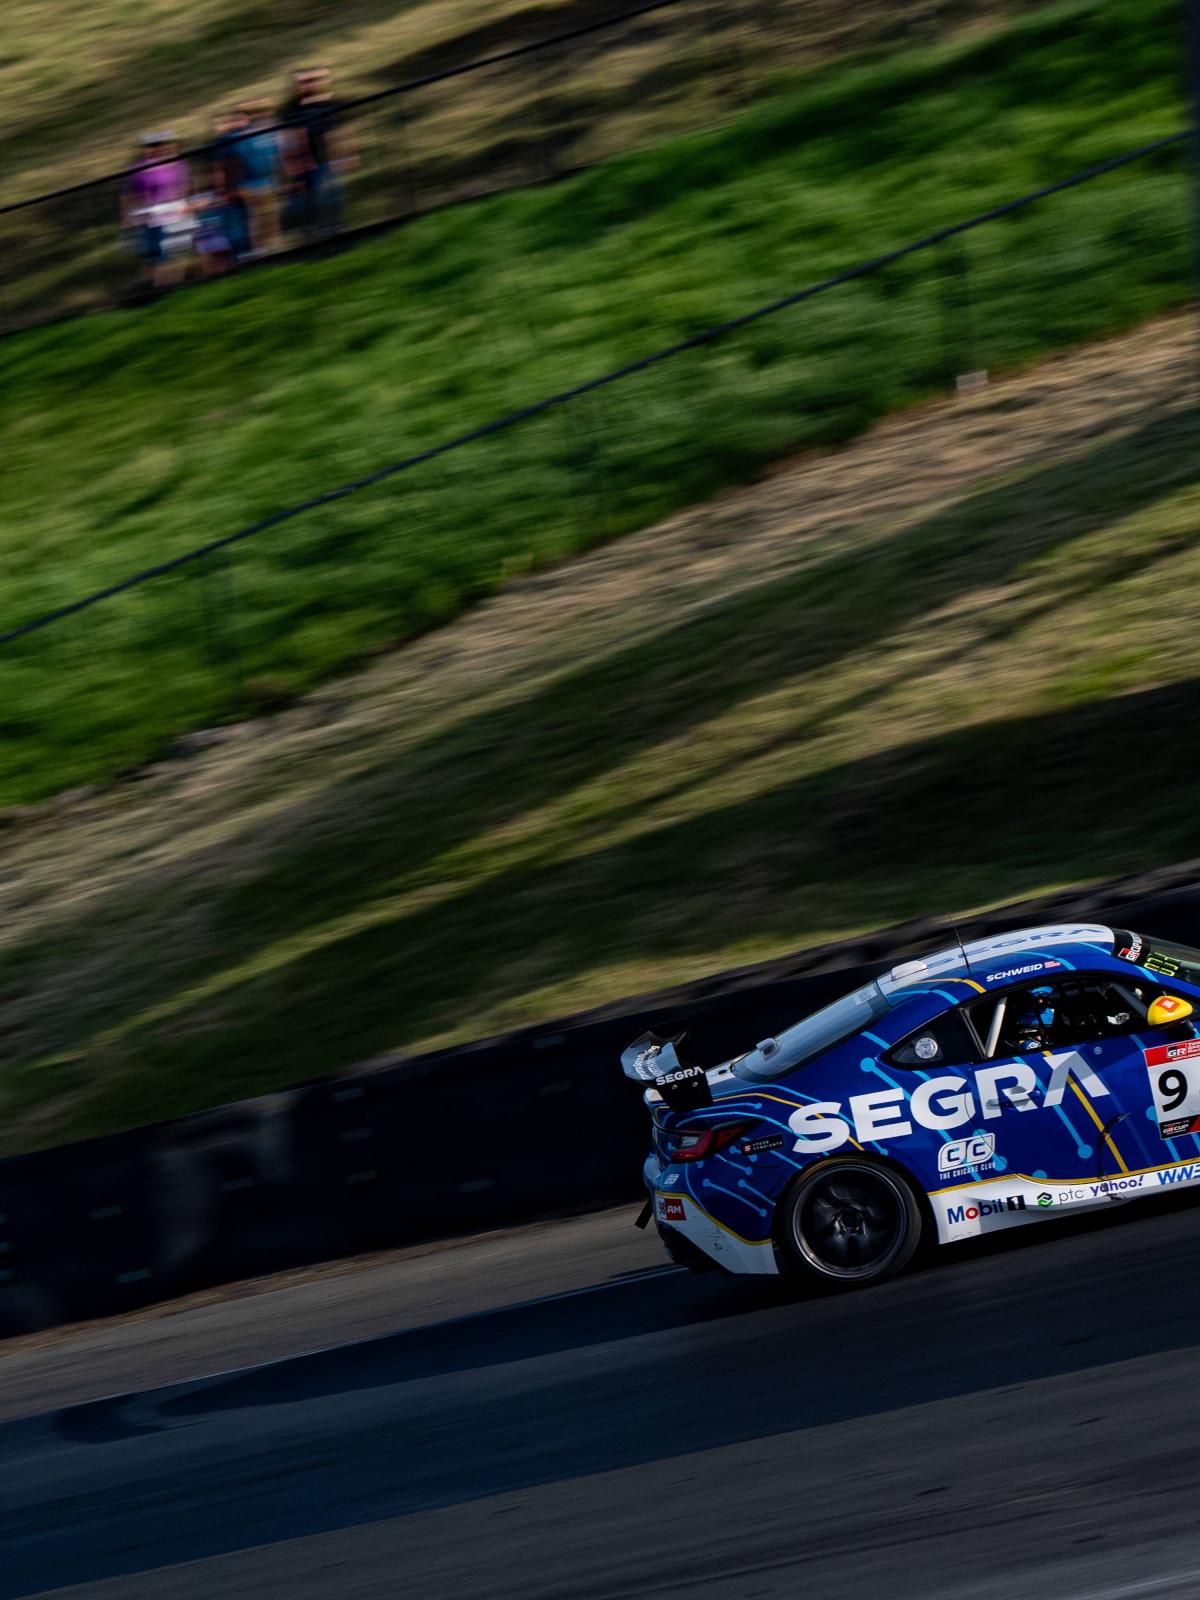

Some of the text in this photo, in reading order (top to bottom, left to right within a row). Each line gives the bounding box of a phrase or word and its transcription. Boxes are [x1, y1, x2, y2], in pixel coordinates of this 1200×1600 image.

[986, 963, 1043, 982] SCHWEID
[1167, 1046, 1187, 1057] GR
[655, 1066, 704, 1086] SEGRA
[788, 1051, 1110, 1154] SEGRA
[980, 1161, 996, 1171] CLUB
[1090, 1175, 1144, 1197] yahoo!
[1058, 1187, 1084, 1205] ptc
[667, 1205, 682, 1214] AM
[946, 1194, 1027, 1224] Mobil 1
